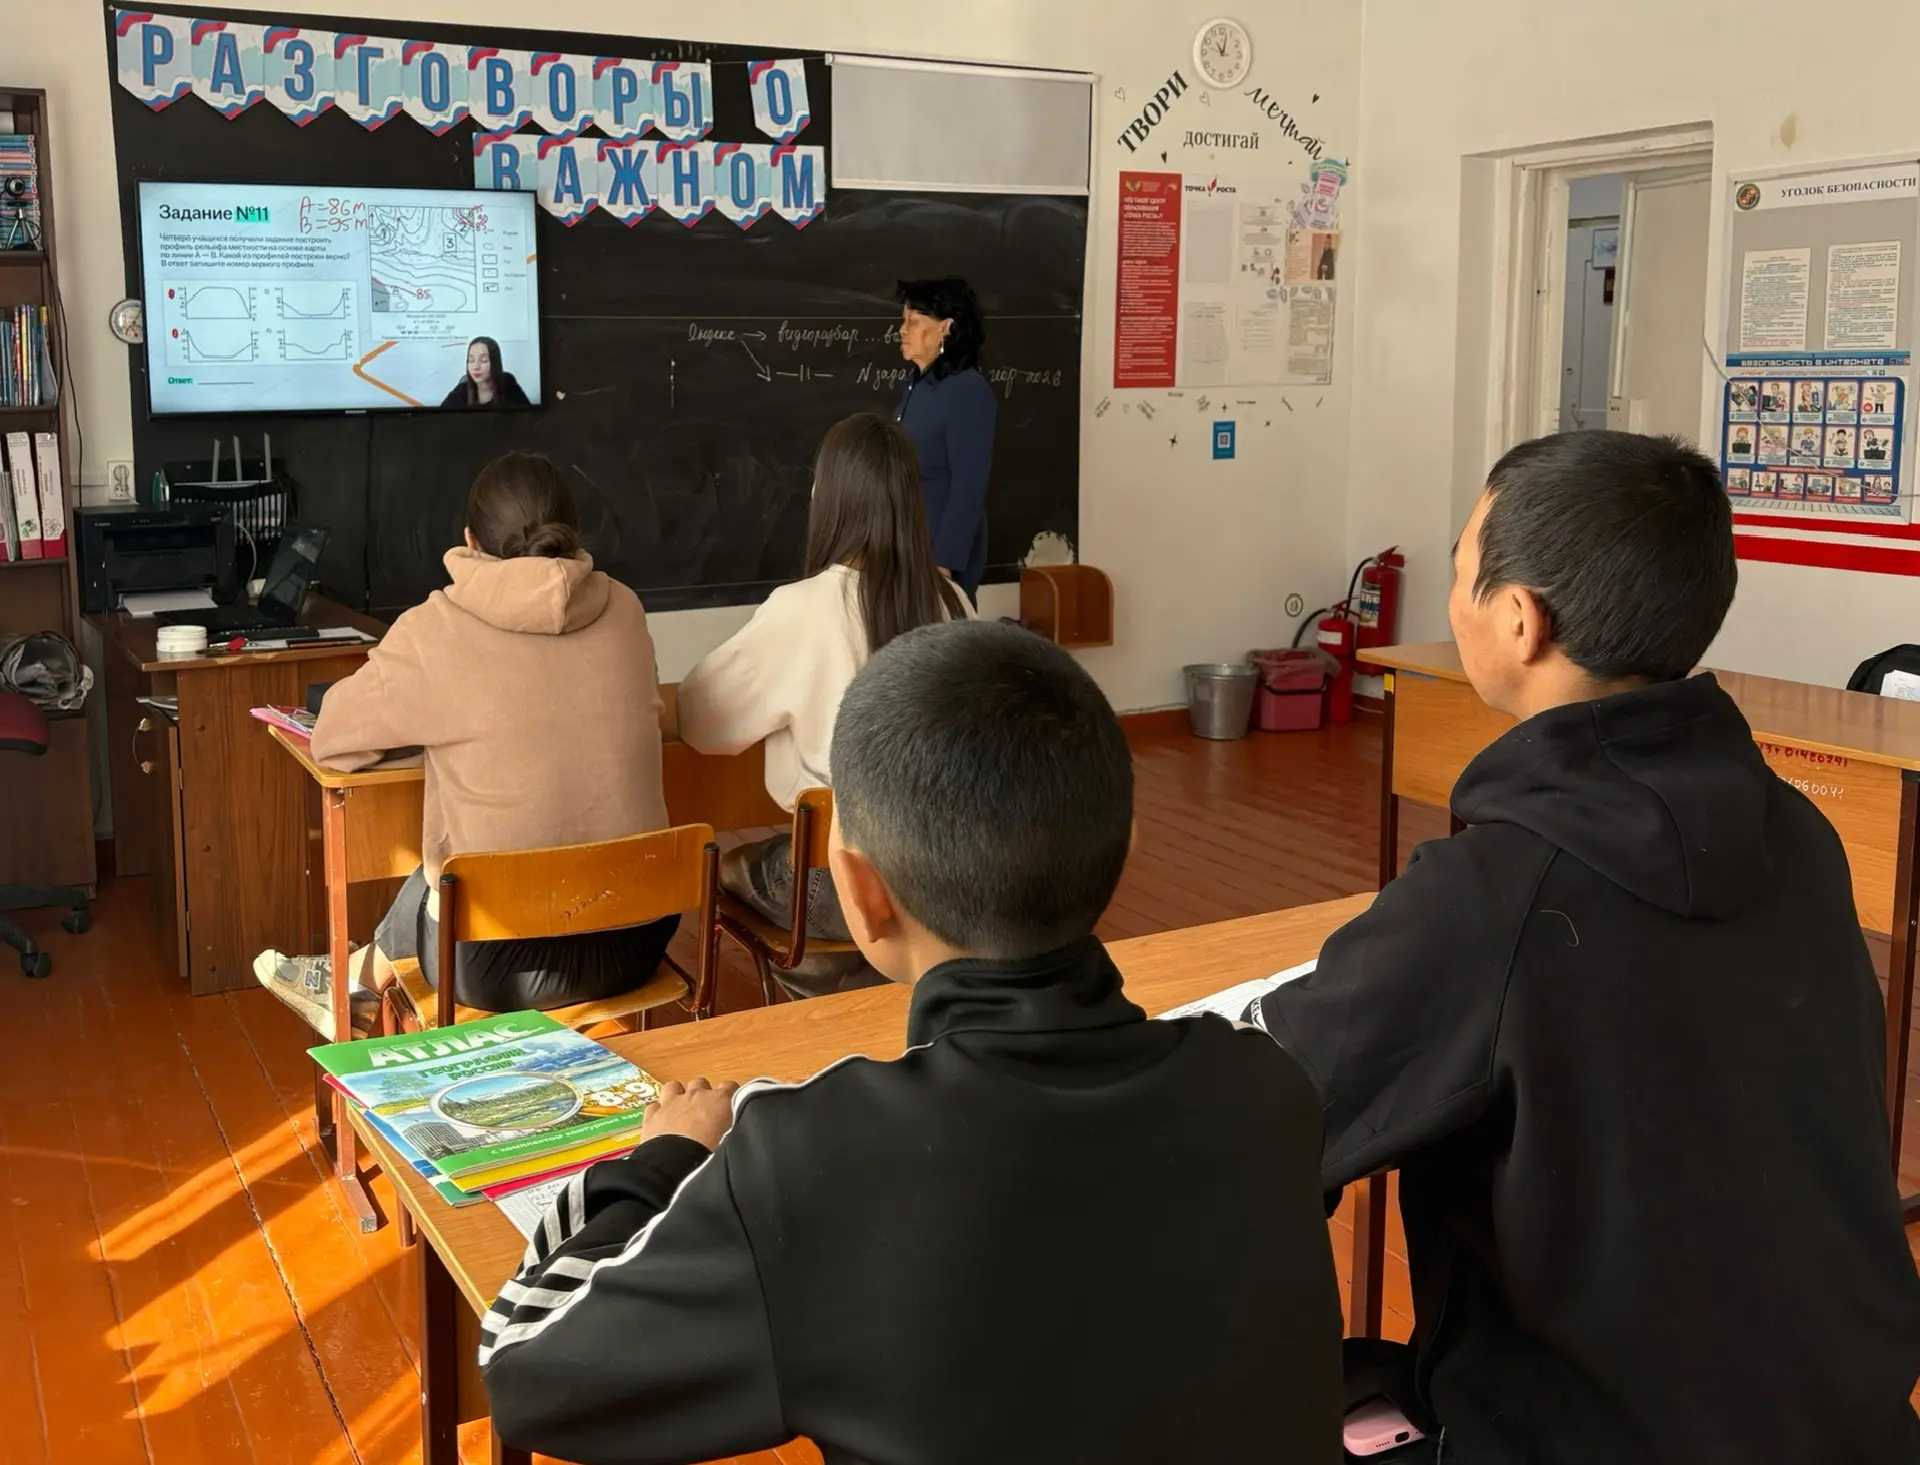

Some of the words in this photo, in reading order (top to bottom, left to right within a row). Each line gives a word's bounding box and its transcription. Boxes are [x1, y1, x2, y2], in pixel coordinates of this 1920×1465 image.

[141, 23, 700, 129] РАЗГОВОРЫ
[765, 68, 793, 126] О
[1117, 70, 1189, 154] ТВОРИ
[1183, 131, 1260, 150] достигай
[492, 143, 814, 209] ВАЖНОМ
[1781, 186, 1824, 198] УГОЛОК
[1827, 177, 1916, 194] БЕЗОПАСНОСТИ
[159, 204, 233, 221] Задание
[236, 206, 269, 220] №11
[160, 243, 194, 252] профиль
[446, 238, 454, 249] 3
[219, 251, 241, 259] Какой
[252, 252, 289, 261] профилей
[1741, 359, 1813, 367] БЕЗОПАСНОСТЬ
[1825, 358, 1885, 366] ИНТЕРНЕТЕ
[368, 1022, 545, 1067] АТЛАС
[566, 1118, 620, 1137] контурных
